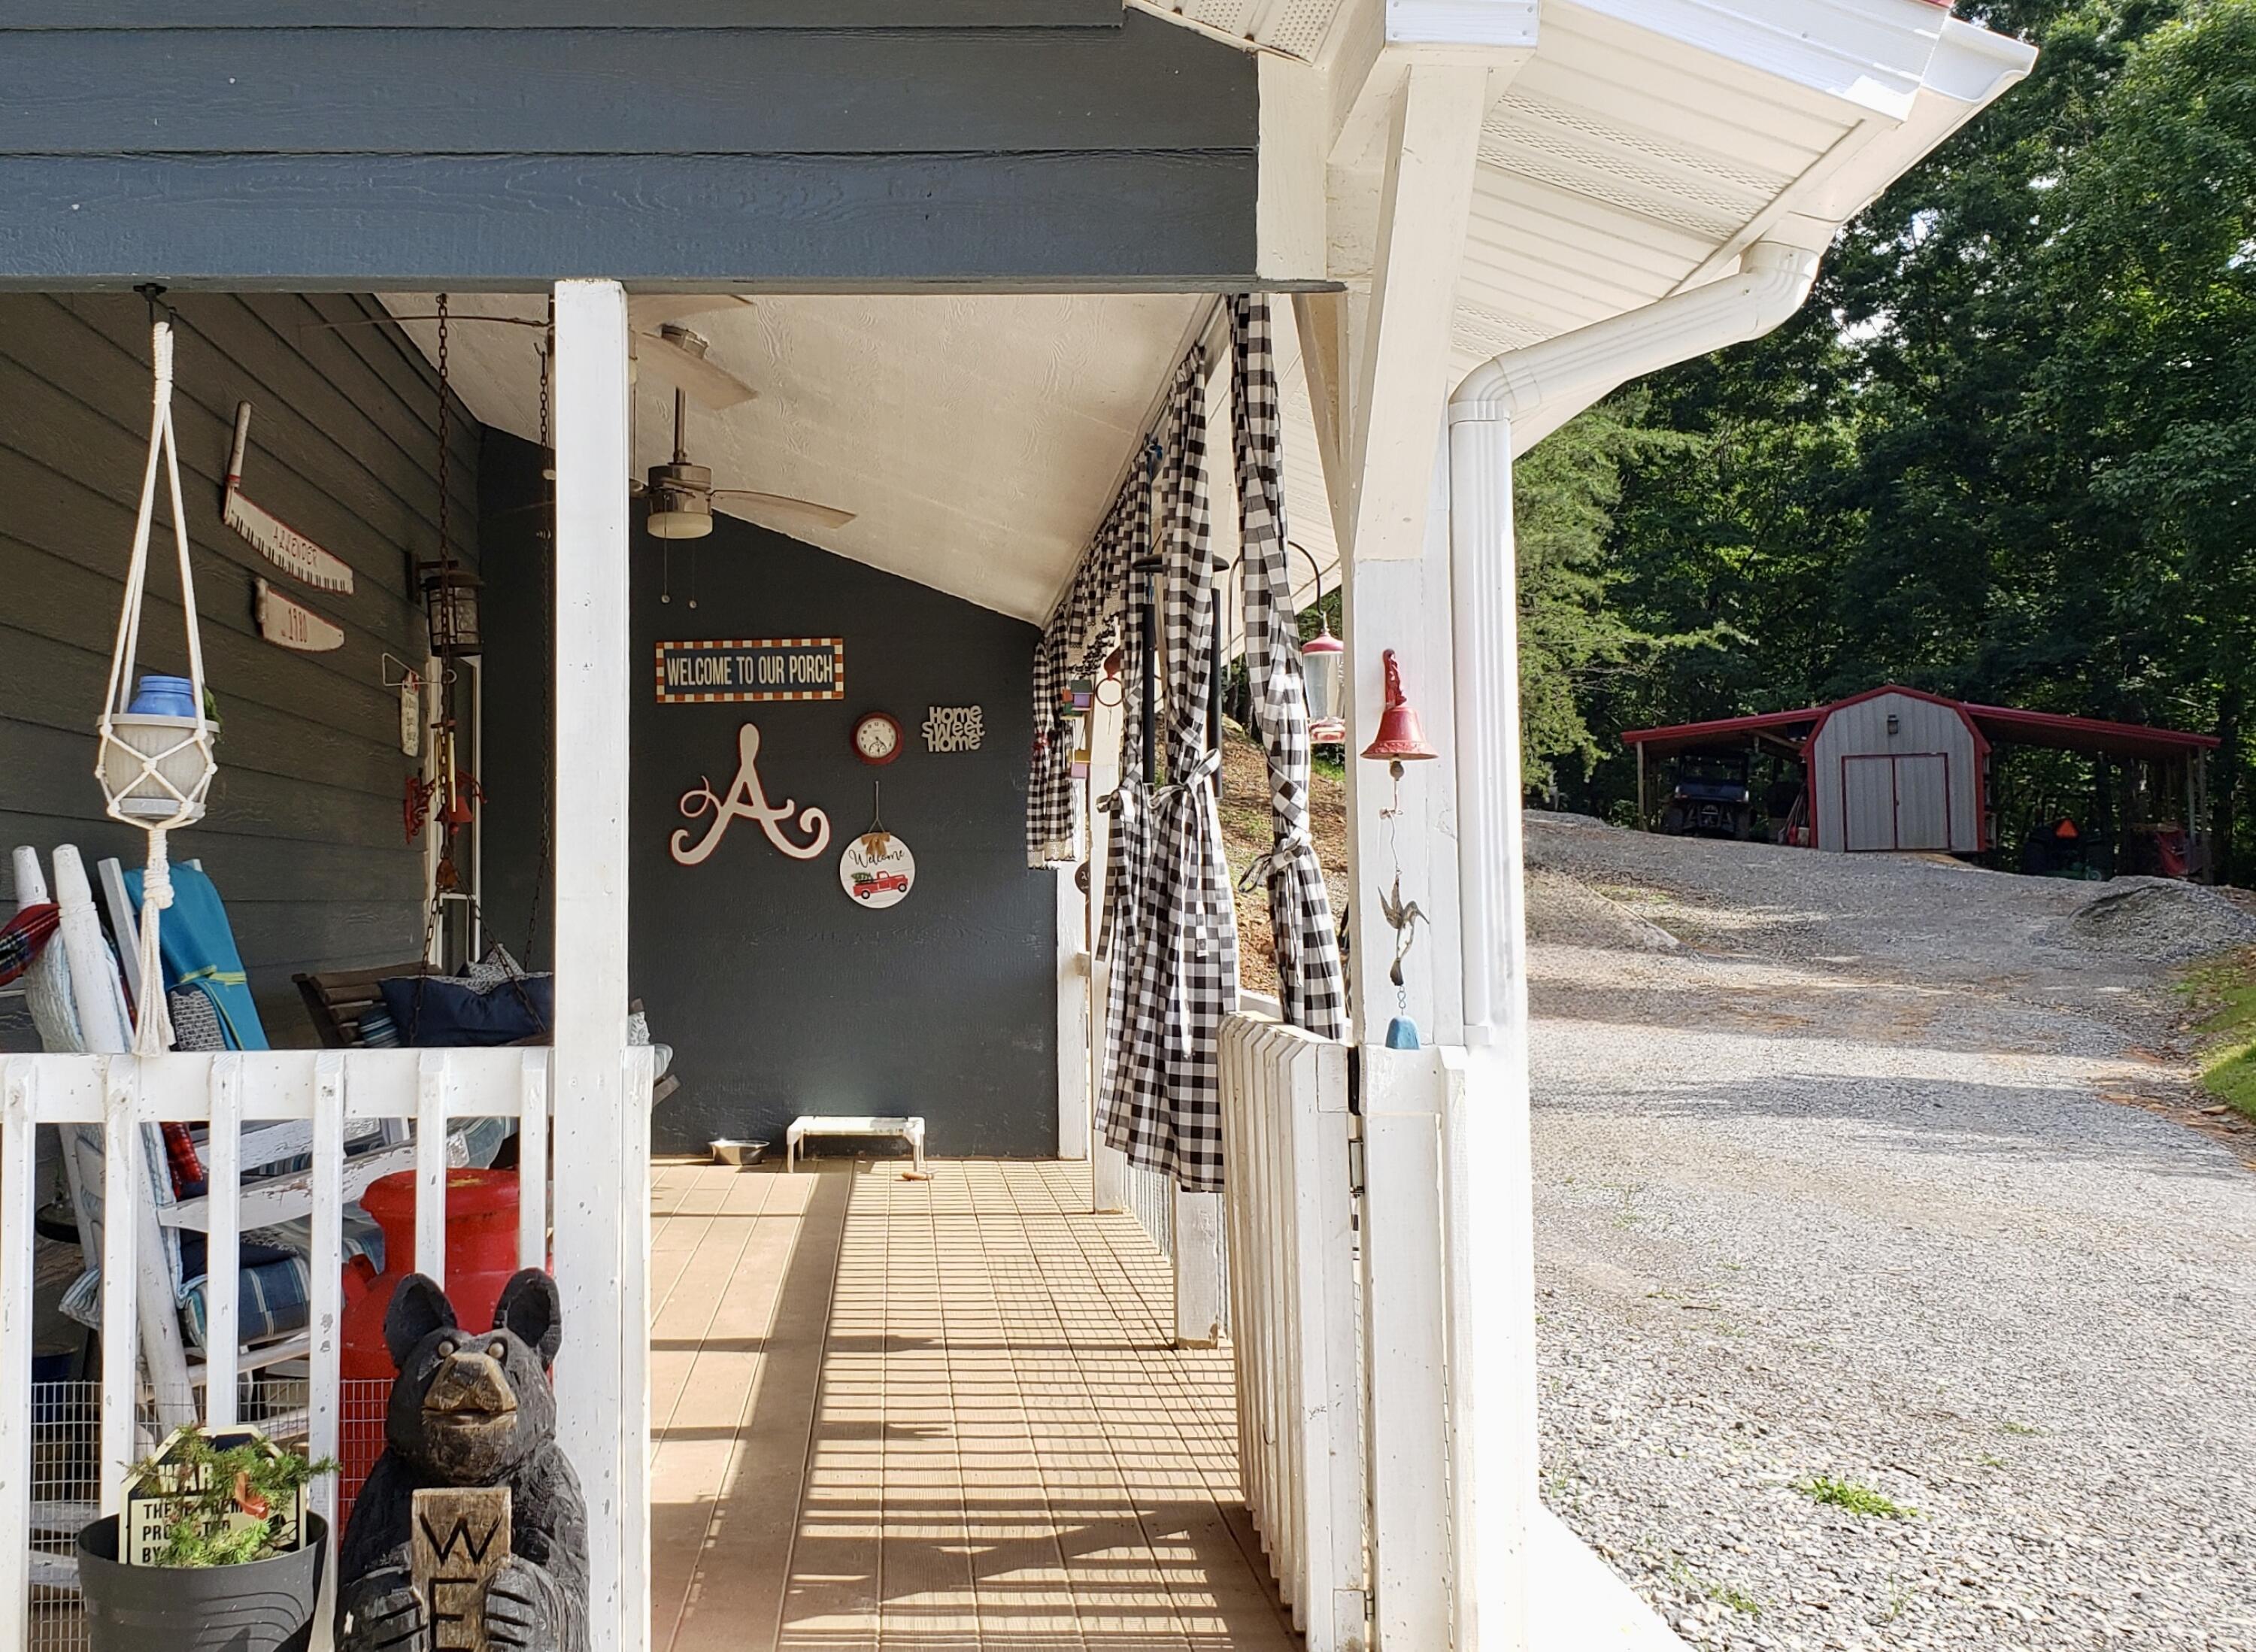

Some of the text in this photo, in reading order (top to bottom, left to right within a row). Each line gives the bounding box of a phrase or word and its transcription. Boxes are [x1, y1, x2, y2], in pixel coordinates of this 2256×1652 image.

[666, 654, 833, 686] WELCOME TO OUR PORCH
[929, 705, 983, 723] Home
[927, 734, 981, 752] Home
[671, 723, 830, 865] A
[848, 849, 905, 868] Welcome
